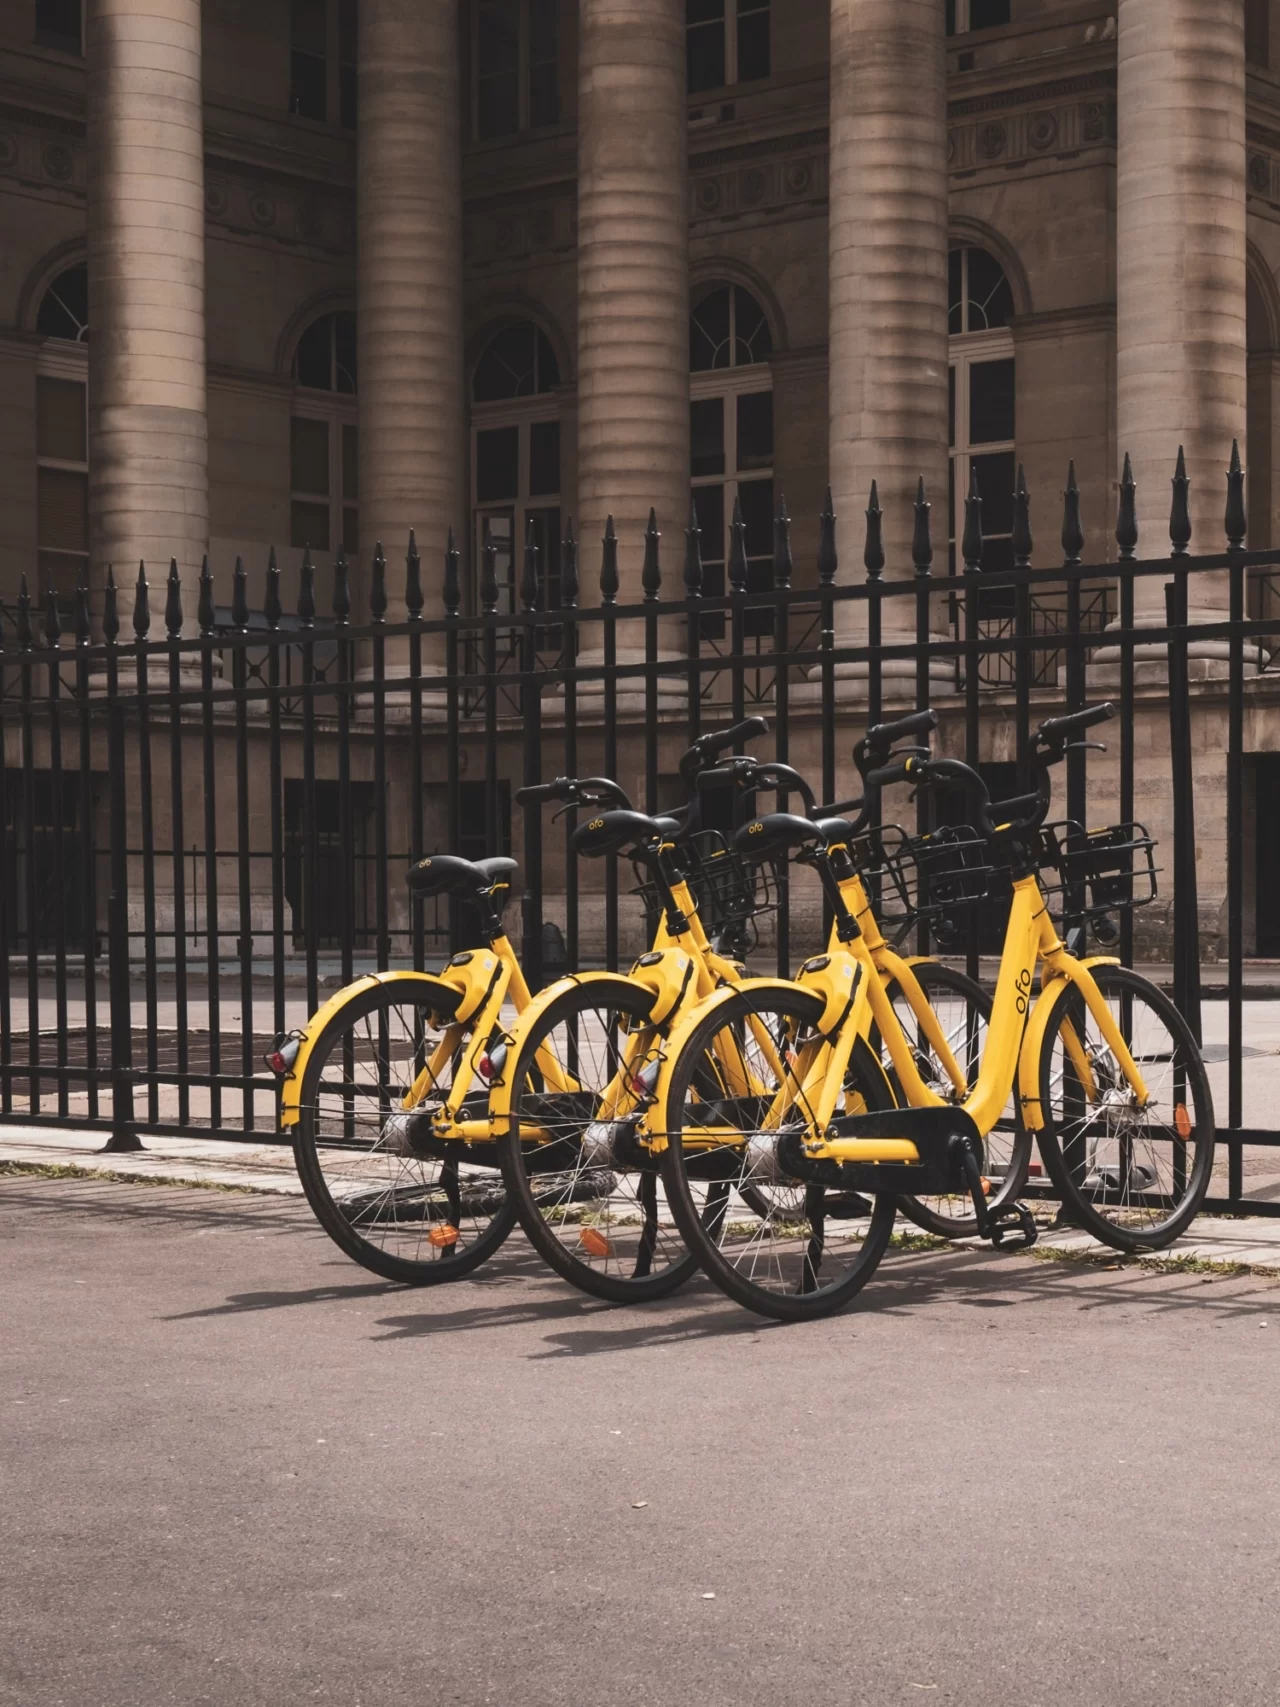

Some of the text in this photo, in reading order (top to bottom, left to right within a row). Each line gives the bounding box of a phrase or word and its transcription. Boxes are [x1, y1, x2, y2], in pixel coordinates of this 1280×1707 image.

[588, 818, 604, 830] ofo
[748, 822, 763, 834] ofo
[1015, 968, 1031, 1014] ofo
